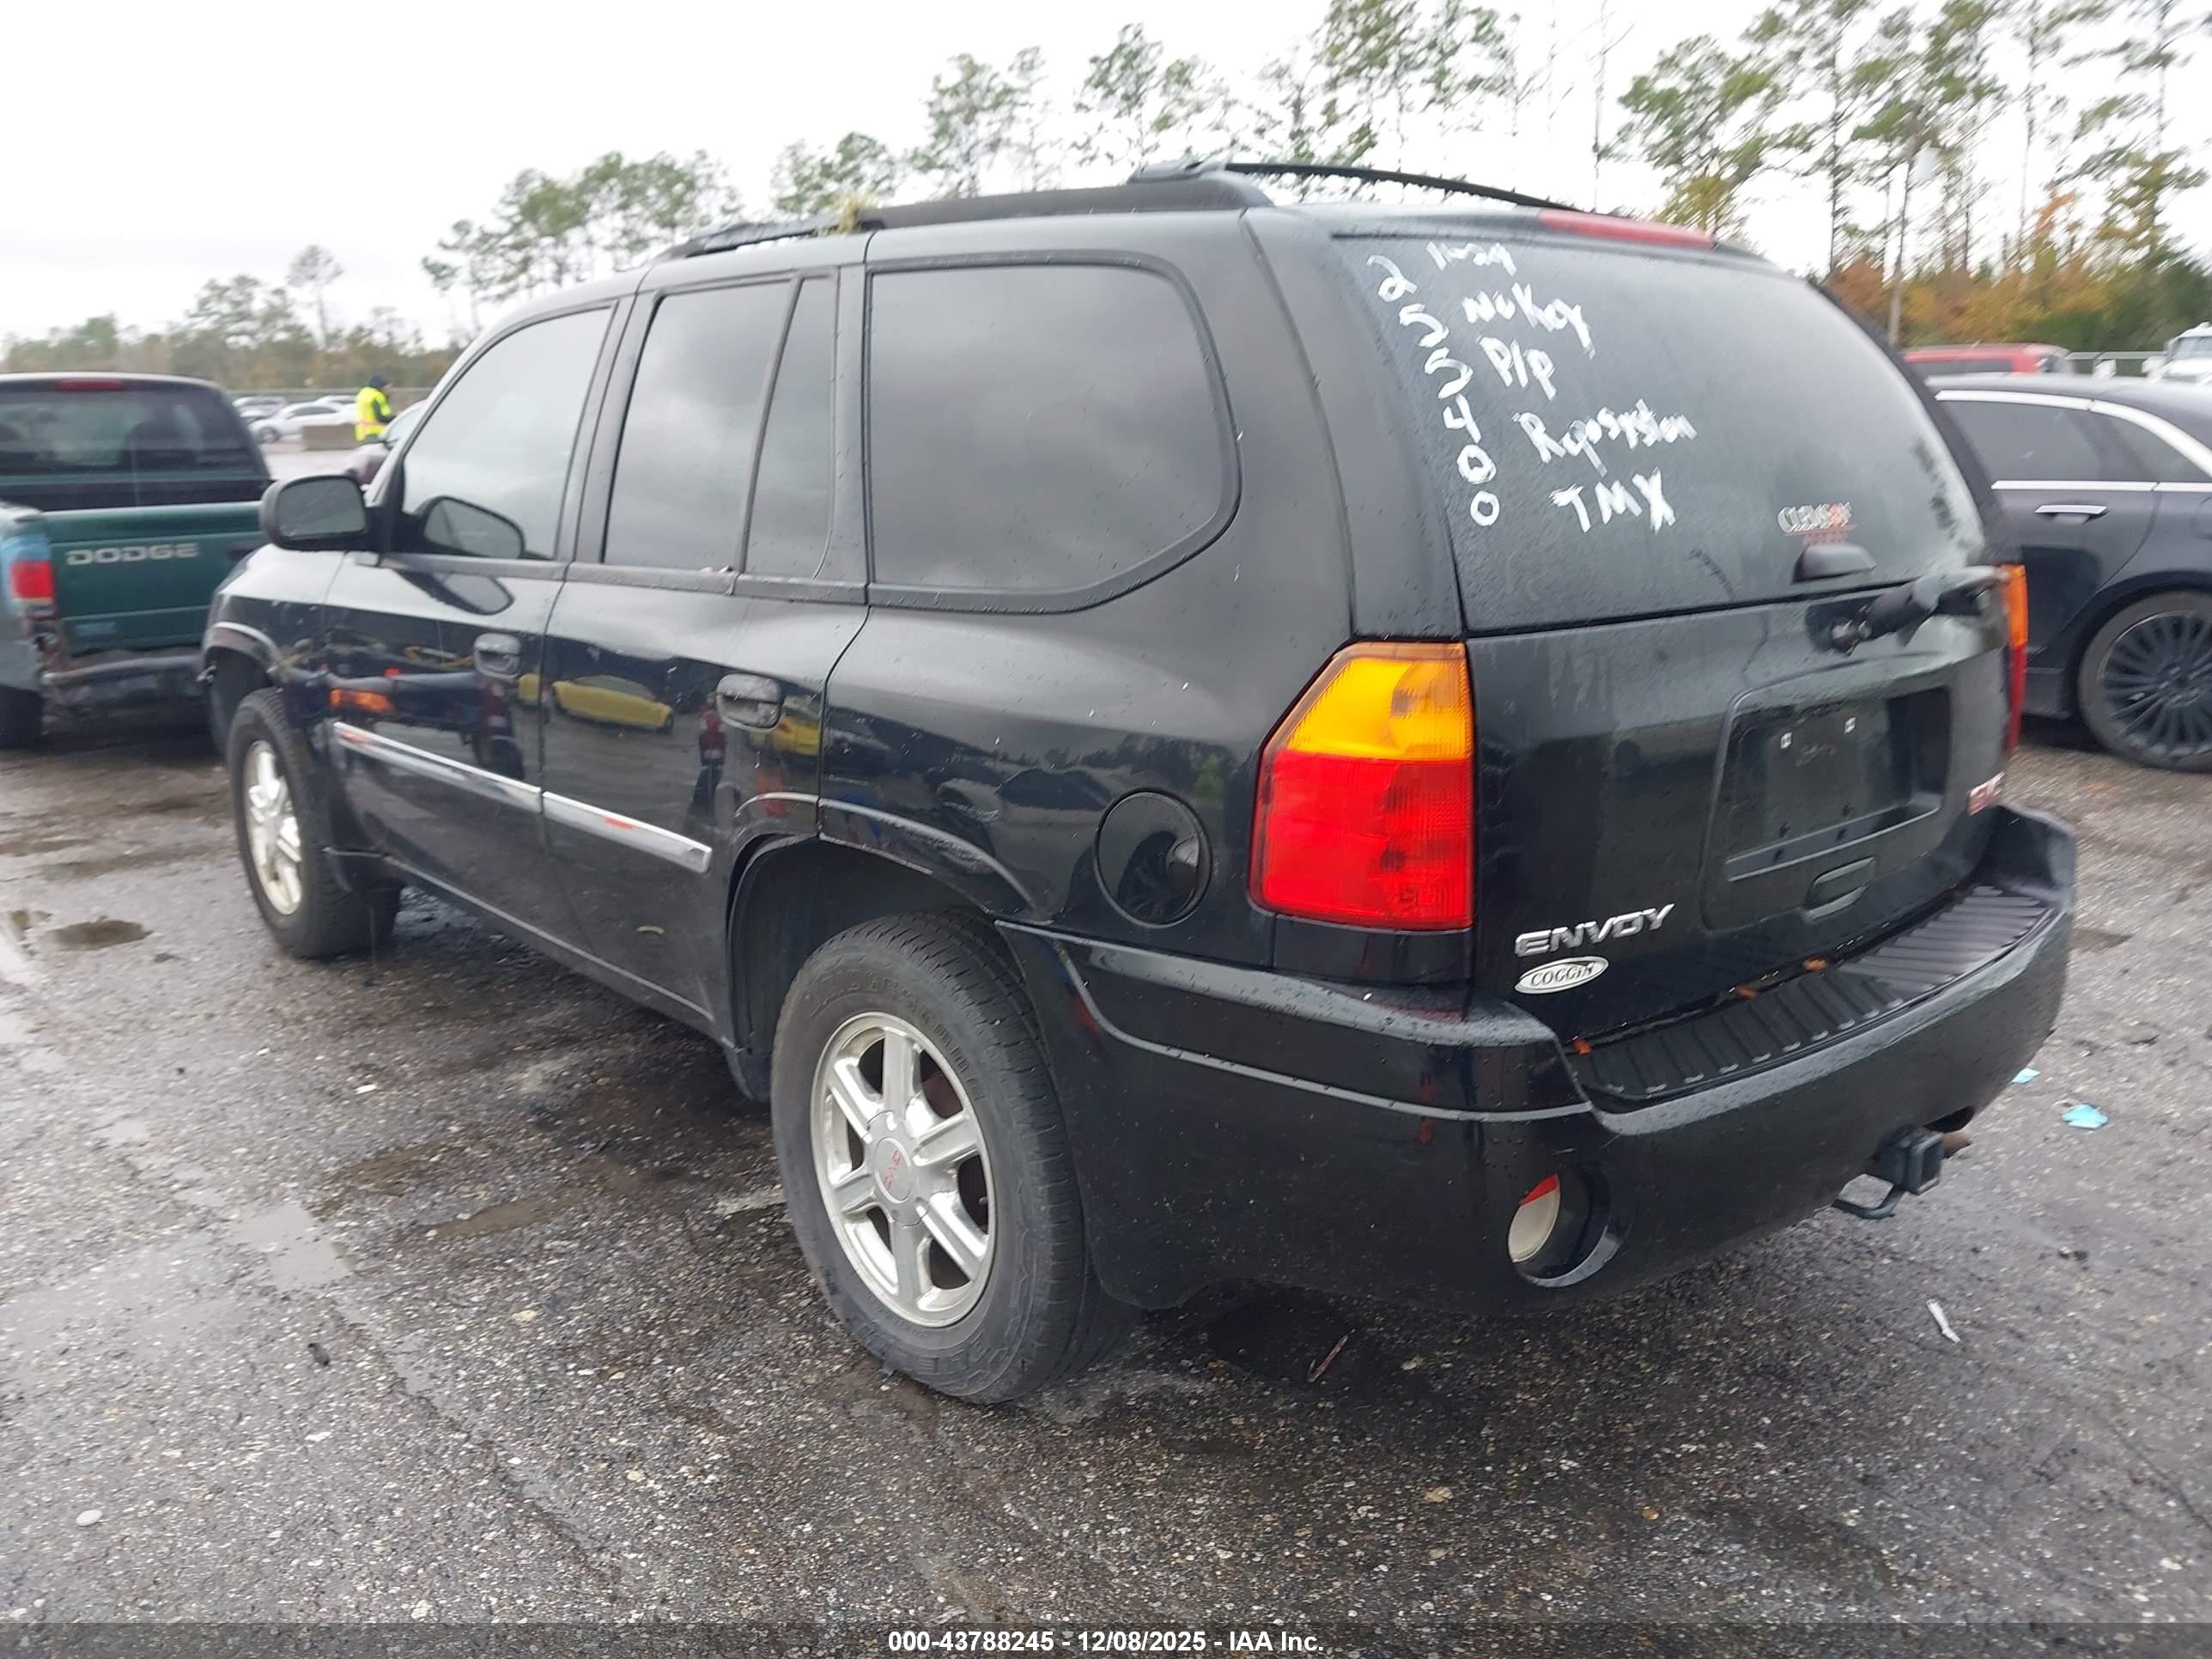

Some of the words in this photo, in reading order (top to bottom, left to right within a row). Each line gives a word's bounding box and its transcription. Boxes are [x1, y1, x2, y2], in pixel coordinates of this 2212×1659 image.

[1549, 466, 1676, 534] TMX
[65, 543, 198, 566] DODGE
[1515, 903, 1674, 957] ENVOY
